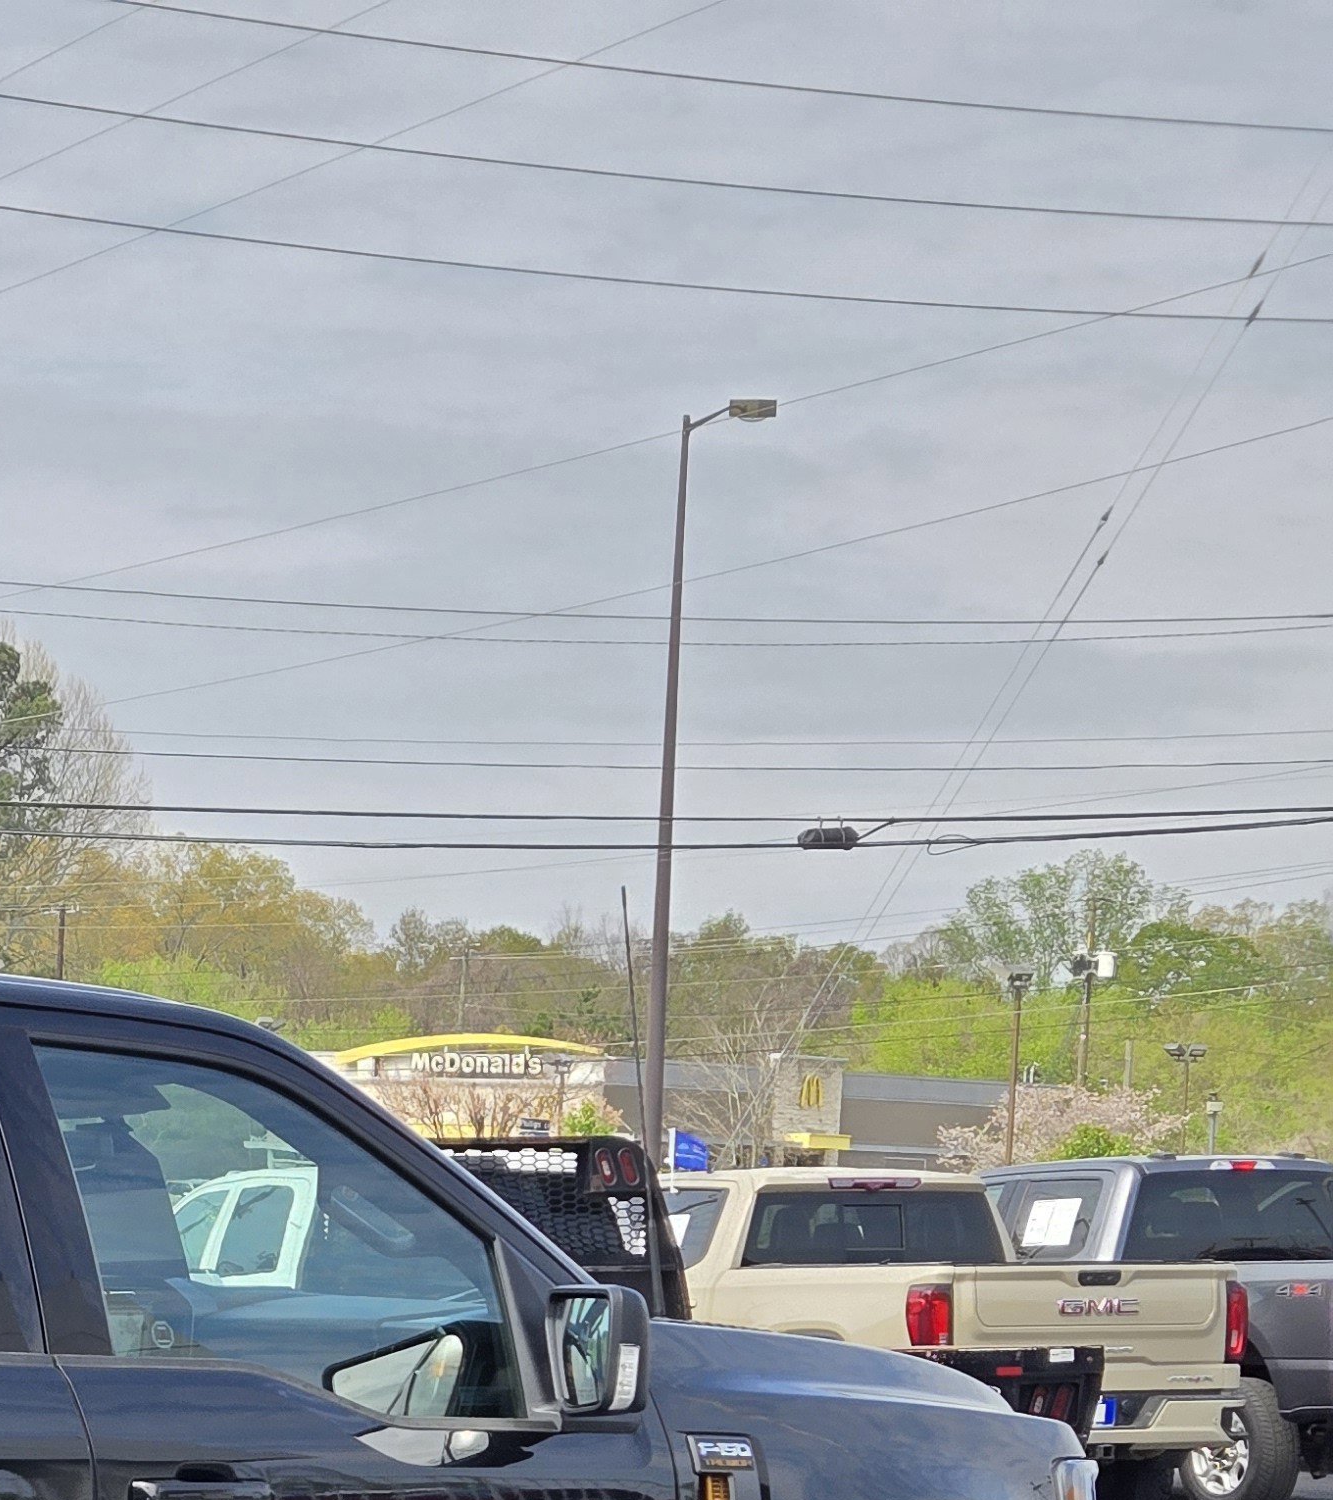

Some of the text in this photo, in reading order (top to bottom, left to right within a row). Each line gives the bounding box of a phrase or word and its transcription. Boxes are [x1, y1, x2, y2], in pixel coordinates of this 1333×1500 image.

[411, 1050, 543, 1076] McDonald's
[1057, 1298, 1139, 1317] GMC
[698, 1442, 752, 1457] F-150
